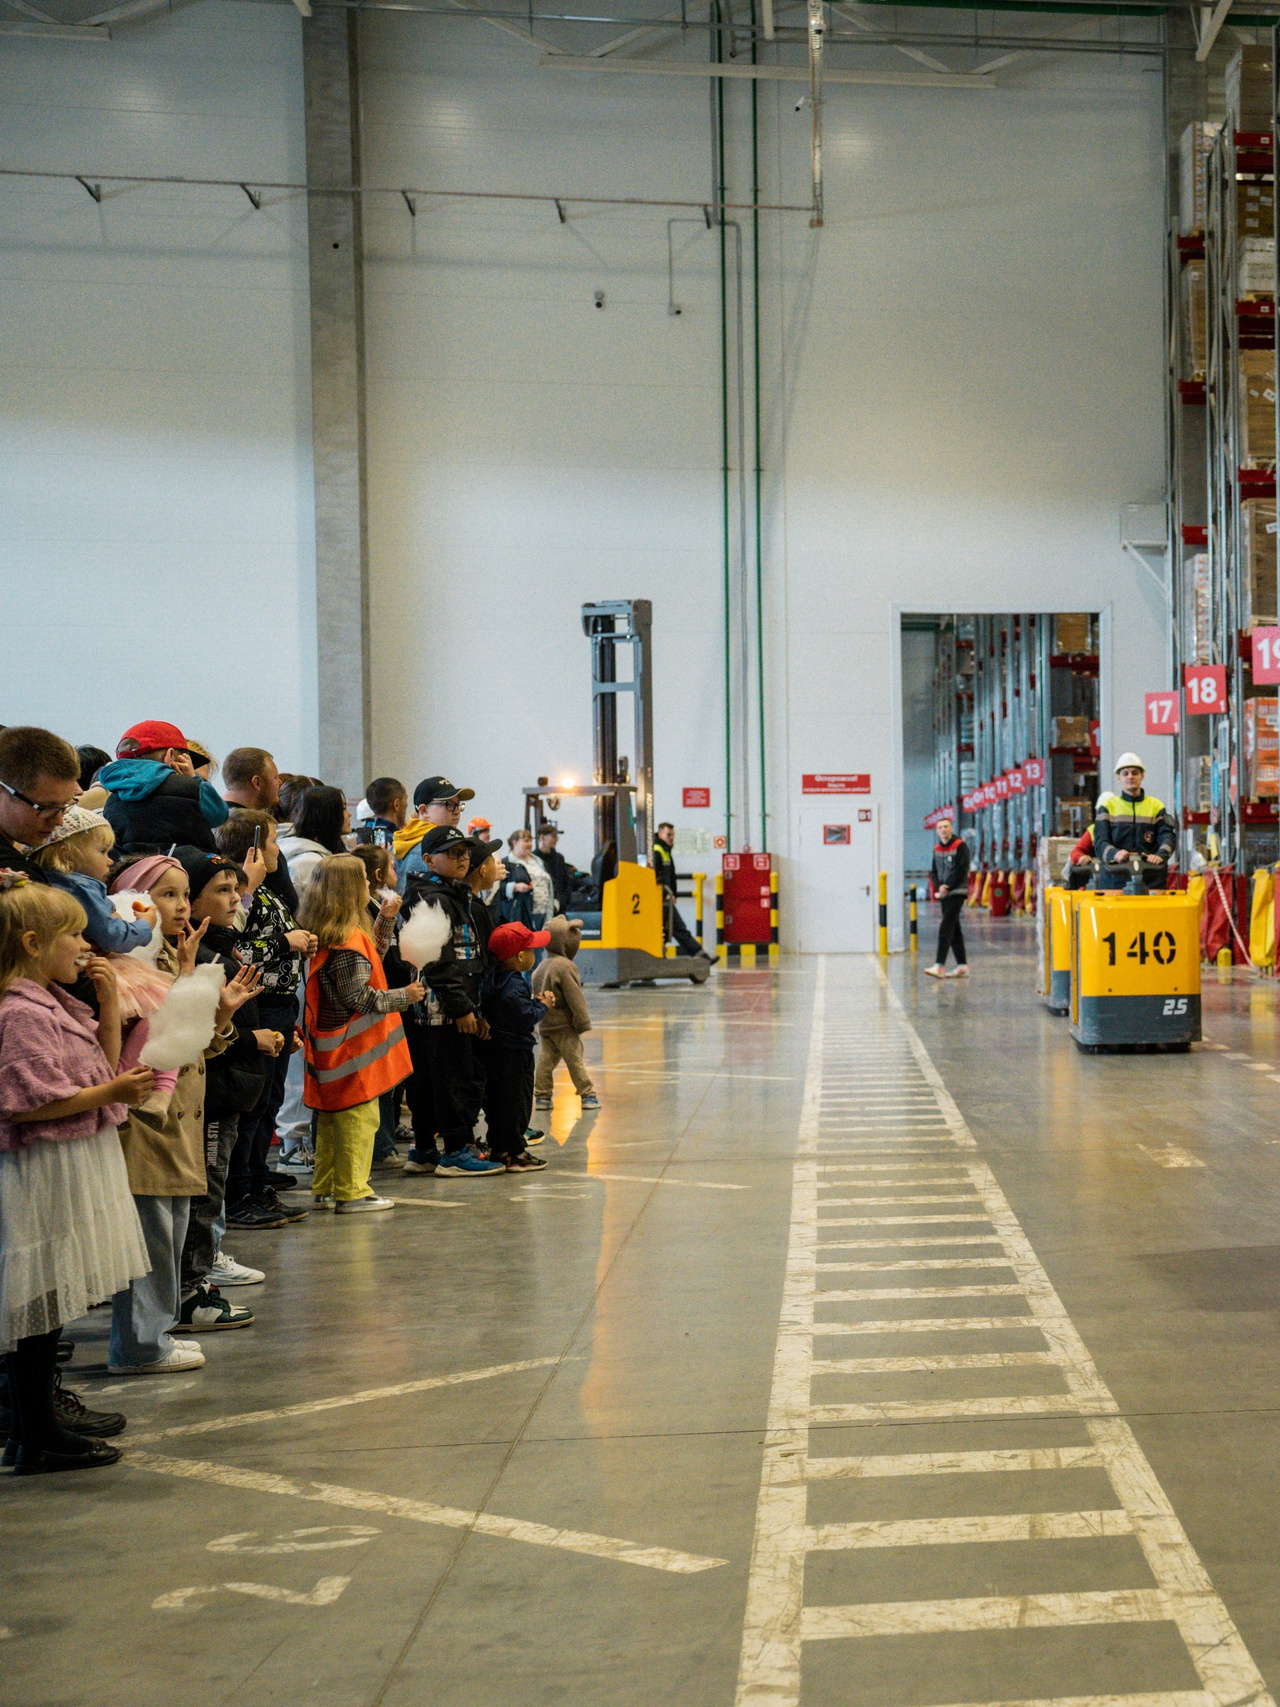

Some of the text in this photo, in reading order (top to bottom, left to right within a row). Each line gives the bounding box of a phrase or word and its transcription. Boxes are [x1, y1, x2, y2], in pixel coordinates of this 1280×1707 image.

[1187, 677, 1217, 704] 18
[1148, 699, 1173, 724] 17
[1219, 700, 1225, 712] 1
[1173, 722, 1179, 733] 1
[1025, 763, 1040, 779] 13
[995, 780, 1007, 793] 11
[1008, 773, 1022, 787] 12
[631, 893, 641, 914] 2
[1102, 931, 1176, 966] 140
[1163, 998, 1188, 1015] 25
